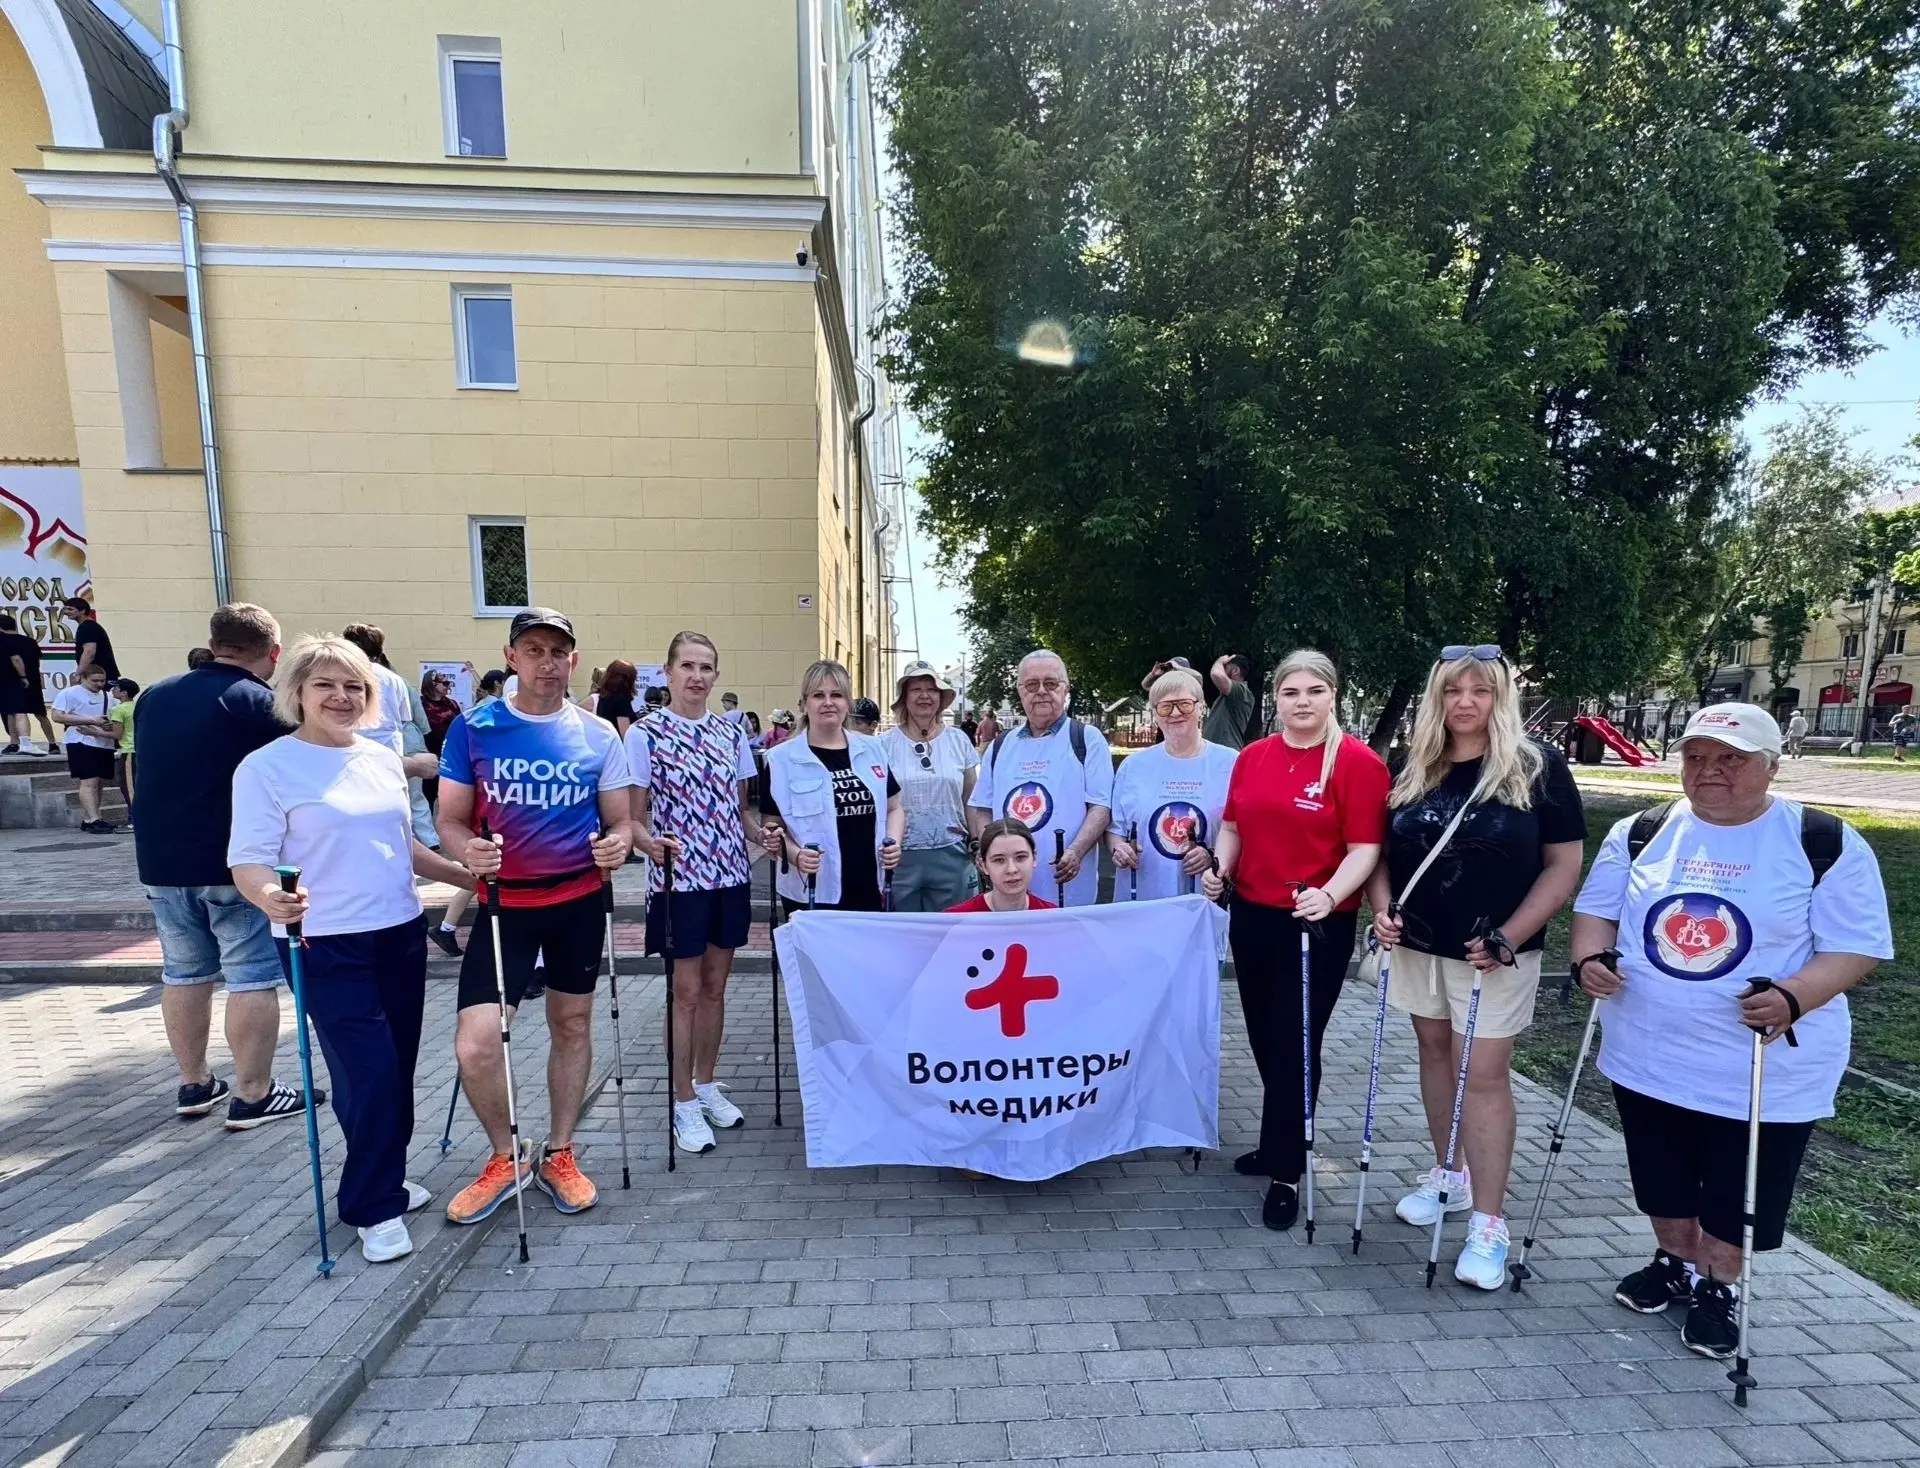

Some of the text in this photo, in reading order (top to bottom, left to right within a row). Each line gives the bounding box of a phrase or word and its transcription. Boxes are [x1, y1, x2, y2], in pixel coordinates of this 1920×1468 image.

[0, 576, 67, 605] ОРОД
[493, 757, 580, 783] КРОСС
[483, 781, 589, 810] НАЦИИ
[907, 1049, 1131, 1086] Волонтеры
[1446, 1121, 1458, 1165] здоровье
[1454, 1078, 1465, 1120] суставов
[1469, 994, 1478, 1022] руках
[949, 1087, 1098, 1124] медики
